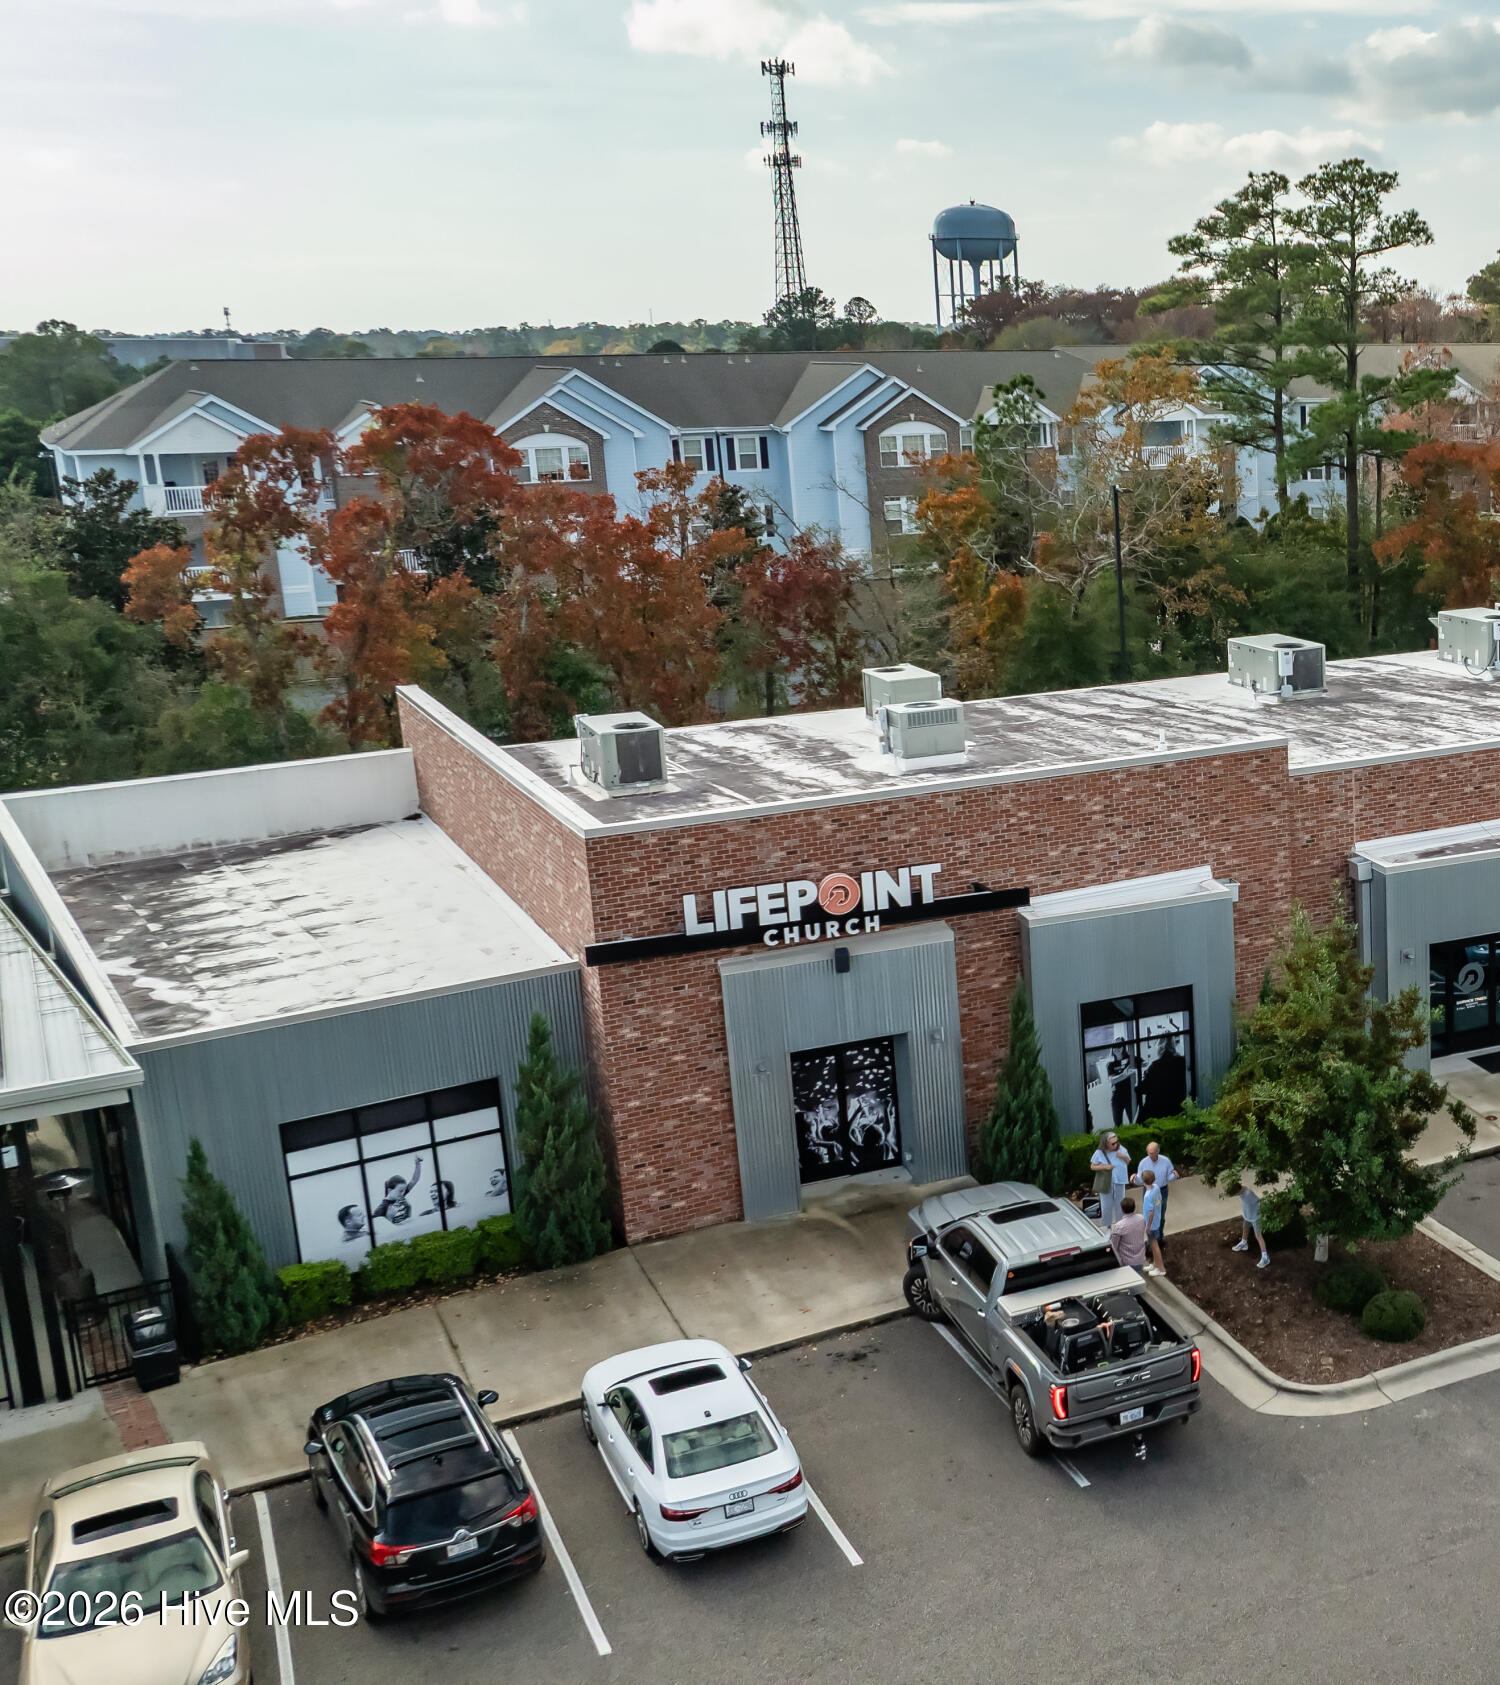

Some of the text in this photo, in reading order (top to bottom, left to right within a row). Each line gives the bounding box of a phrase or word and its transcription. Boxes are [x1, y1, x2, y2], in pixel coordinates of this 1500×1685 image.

[683, 864, 941, 936] LIFEPOINT
[763, 915, 880, 946] CHURCH
[1113, 1370, 1151, 1387] GMC
